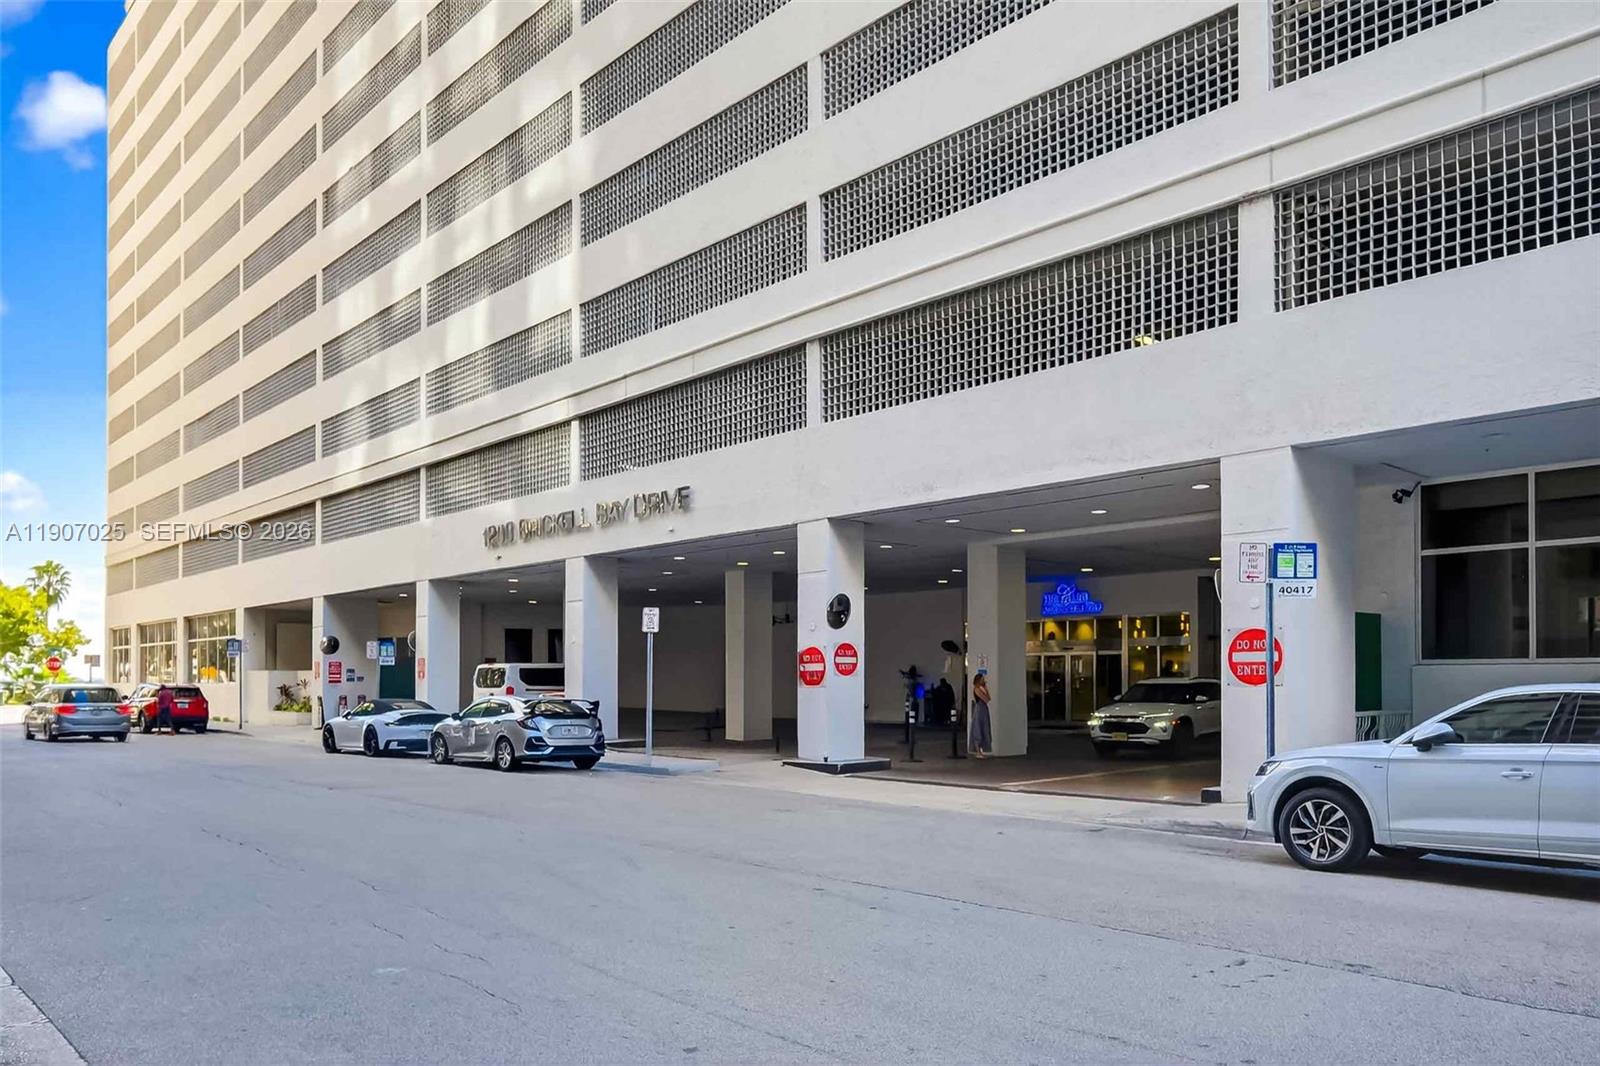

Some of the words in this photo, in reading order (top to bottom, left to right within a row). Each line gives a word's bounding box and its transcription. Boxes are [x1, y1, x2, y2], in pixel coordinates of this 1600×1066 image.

[595, 498, 630, 529] BAY
[633, 485, 691, 520] DRIVE
[1278, 586, 1314, 594] 40417
[1236, 639, 1250, 650] DO
[1253, 639, 1266, 650] NO
[1236, 664, 1266, 676] ENTE
